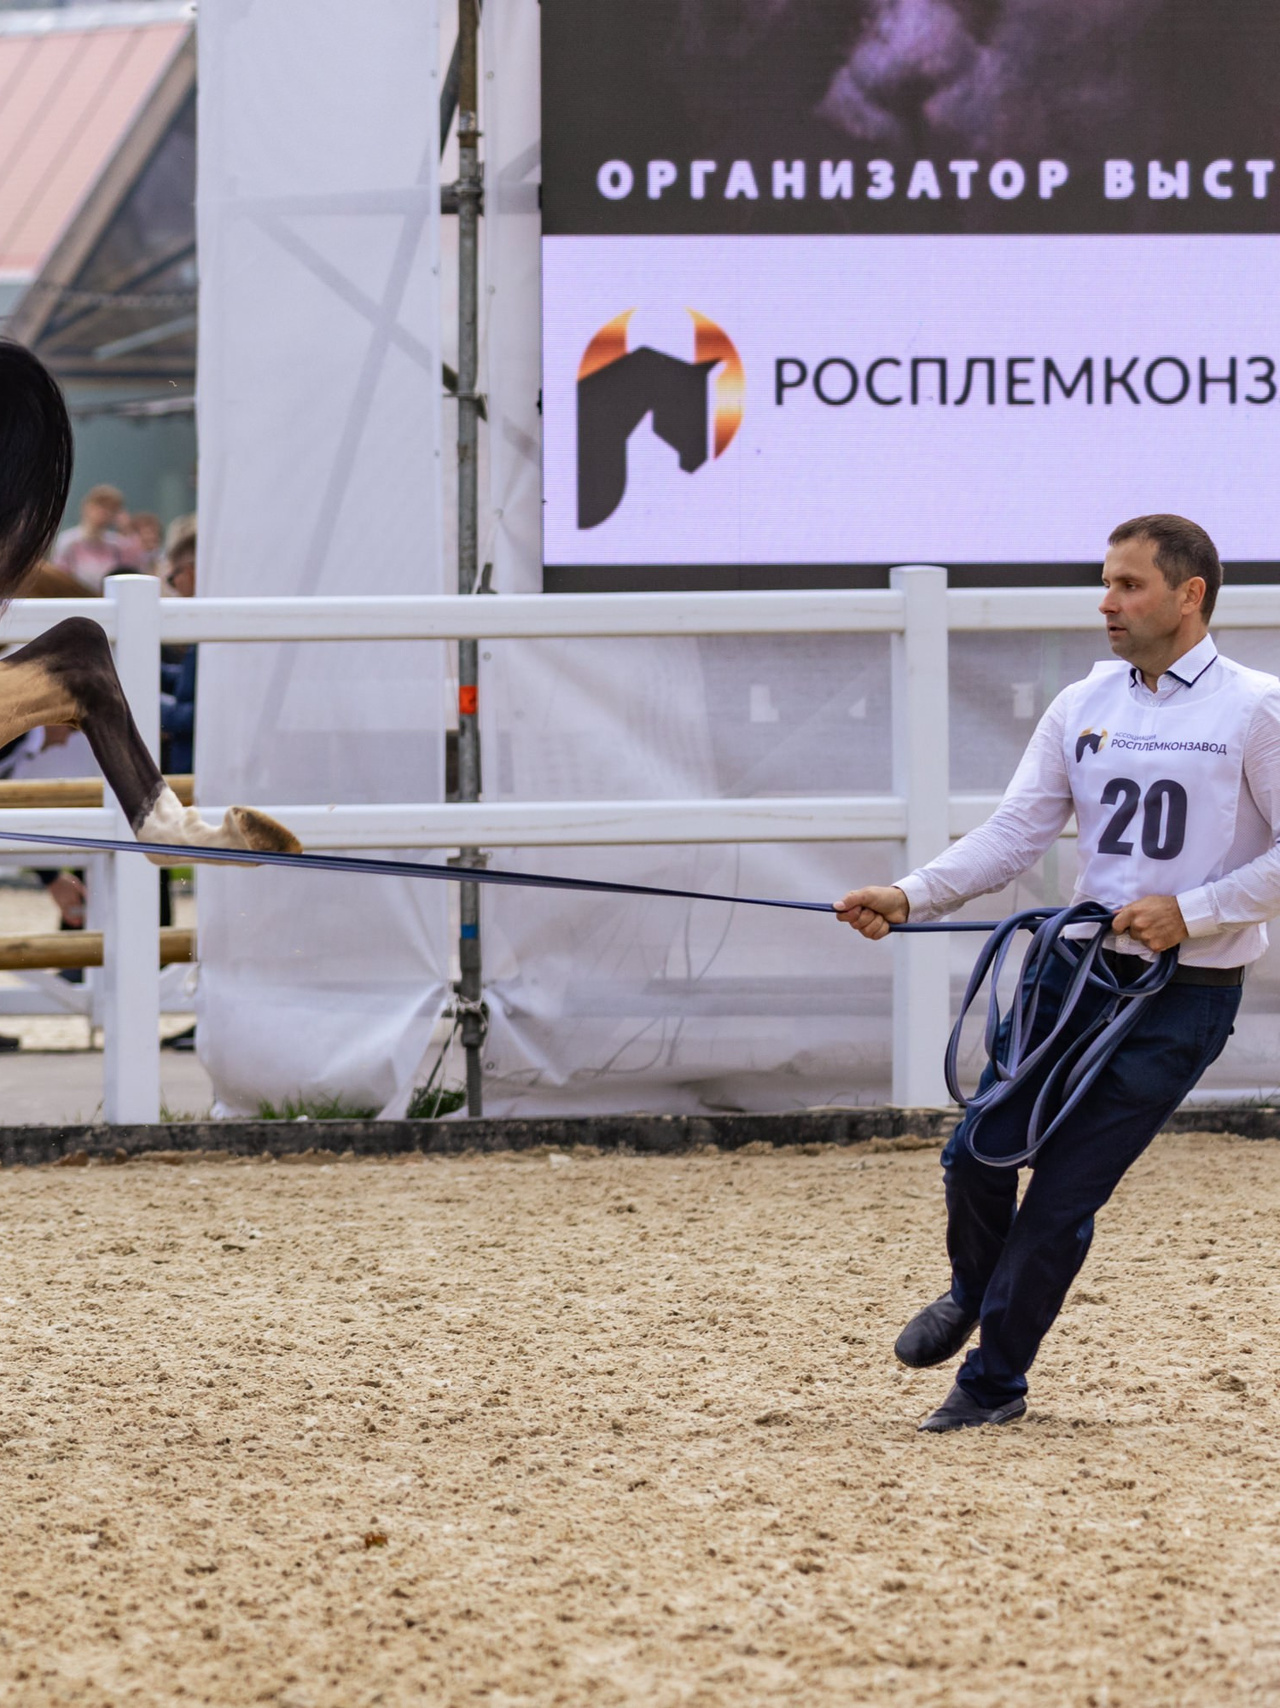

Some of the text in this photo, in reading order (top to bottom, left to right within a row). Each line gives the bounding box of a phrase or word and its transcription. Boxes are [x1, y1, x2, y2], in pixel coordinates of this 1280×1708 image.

[597, 159, 1275, 200] ОРГАНИЗАТОР ВЫСТ
[775, 356, 1278, 406] РОСПЛЕМКОНЗ
[1111, 738, 1228, 756] РОСПЛЕМКОНЗАВОД
[1097, 777, 1188, 861] 20
